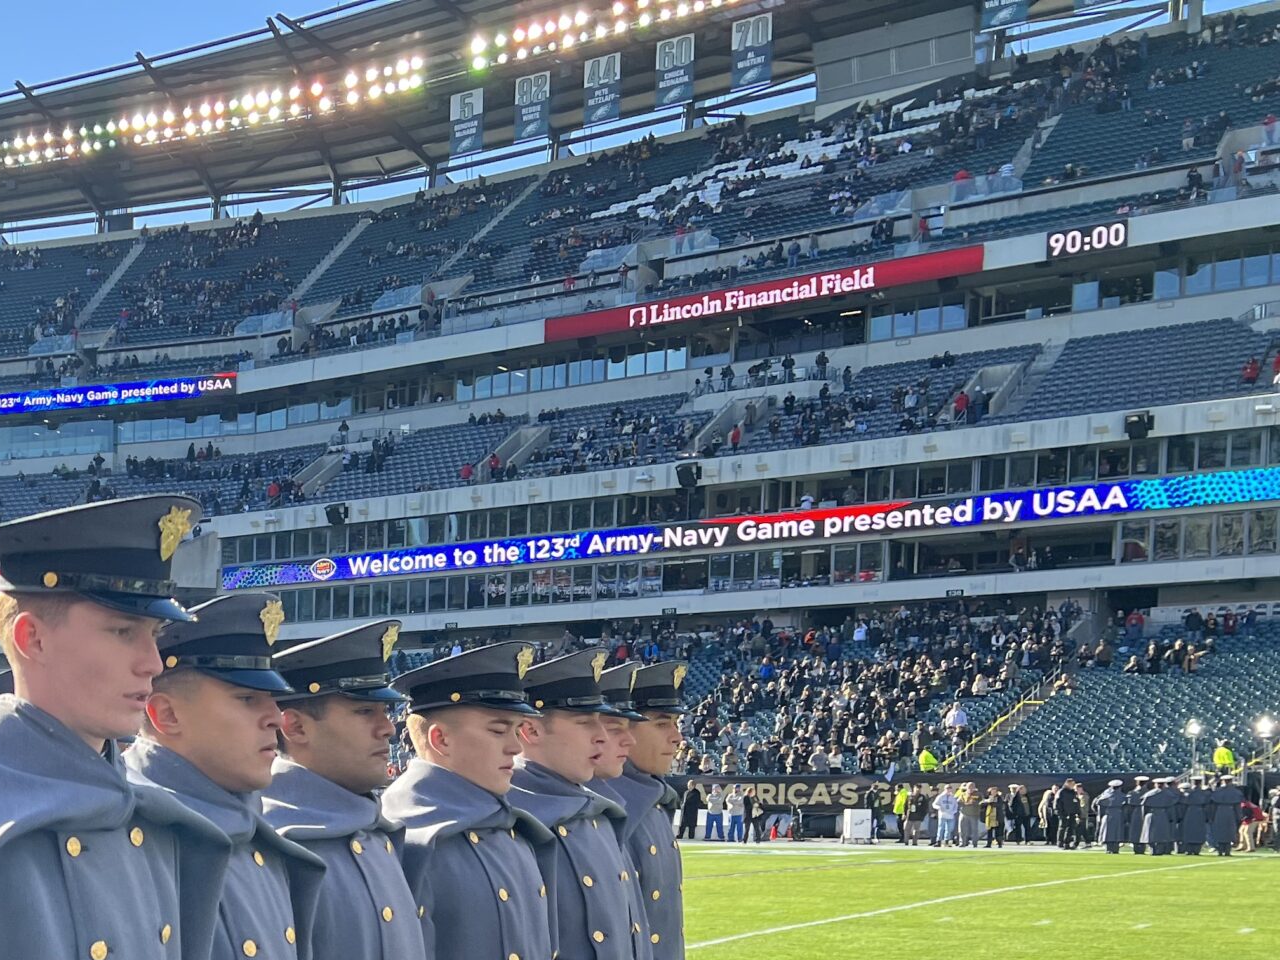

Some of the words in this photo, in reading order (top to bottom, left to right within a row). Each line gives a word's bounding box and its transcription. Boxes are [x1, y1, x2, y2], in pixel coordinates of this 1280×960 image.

[735, 16, 769, 52] 70
[659, 37, 691, 71] 60
[587, 55, 616, 88] 44
[459, 92, 473, 120] 5
[518, 74, 547, 106] 92
[1049, 223, 1125, 256] 90:00
[650, 295, 722, 324] Lincoln
[725, 278, 817, 311] Financial
[820, 267, 875, 295] Field
[24, 393, 83, 406] Army-Navy
[87, 390, 118, 400] Game
[121, 383, 178, 400] presented
[181, 382, 195, 393] by
[198, 379, 232, 391] USAA
[348, 552, 447, 576] Welcome
[453, 548, 477, 566] to
[483, 543, 520, 564] the
[527, 535, 581, 560] 123rd
[587, 523, 728, 555] Army-Navy
[736, 518, 815, 542] Game
[823, 499, 973, 537] presented
[983, 497, 1022, 522] by
[1032, 485, 1129, 516] USAA
